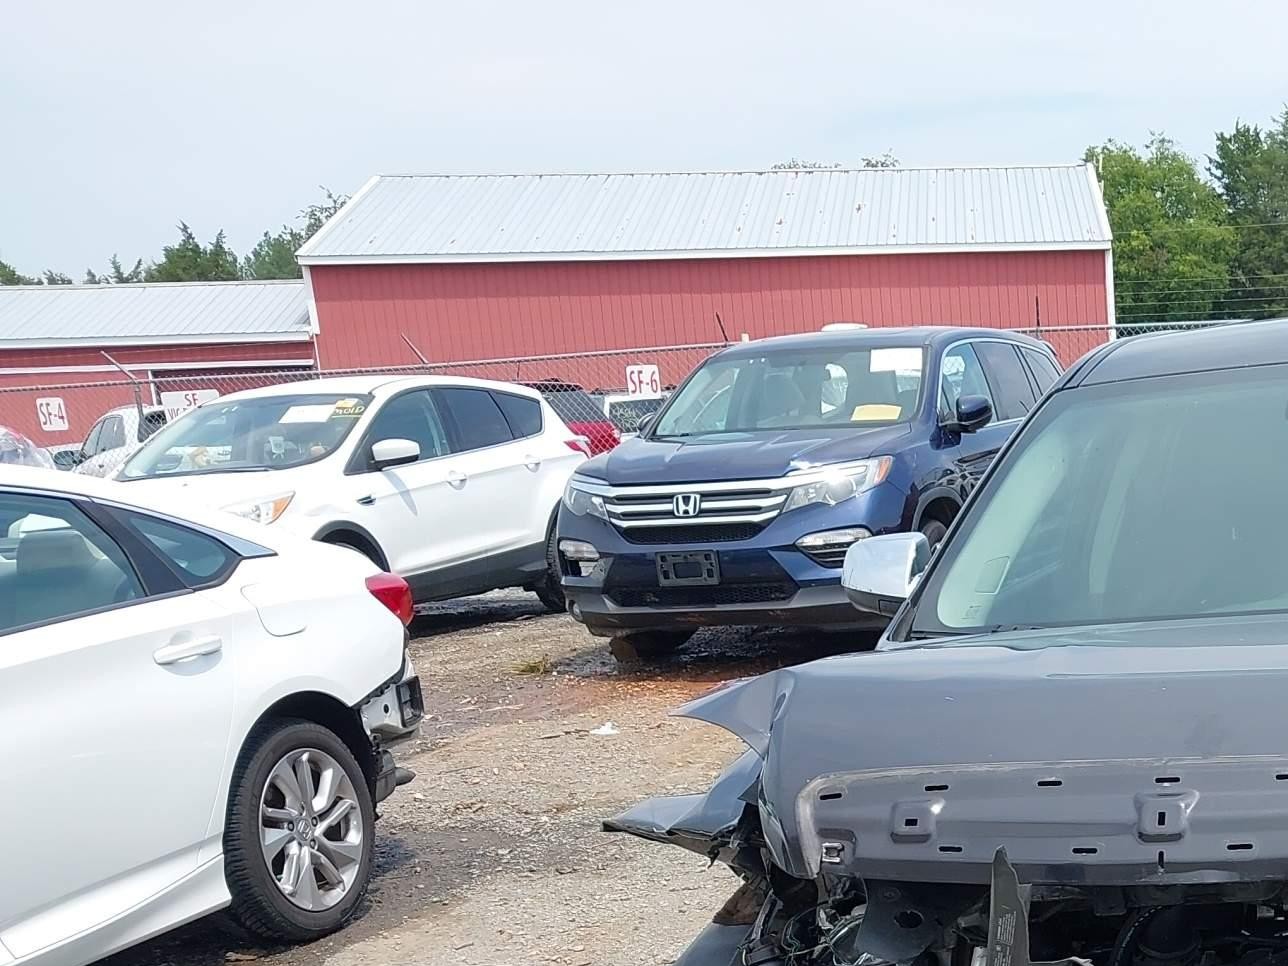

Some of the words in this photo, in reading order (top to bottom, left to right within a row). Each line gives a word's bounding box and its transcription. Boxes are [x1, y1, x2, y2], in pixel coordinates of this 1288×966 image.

[629, 370, 658, 395] SF-6
[184, 393, 199, 407] SF
[38, 402, 66, 426] SF-4
